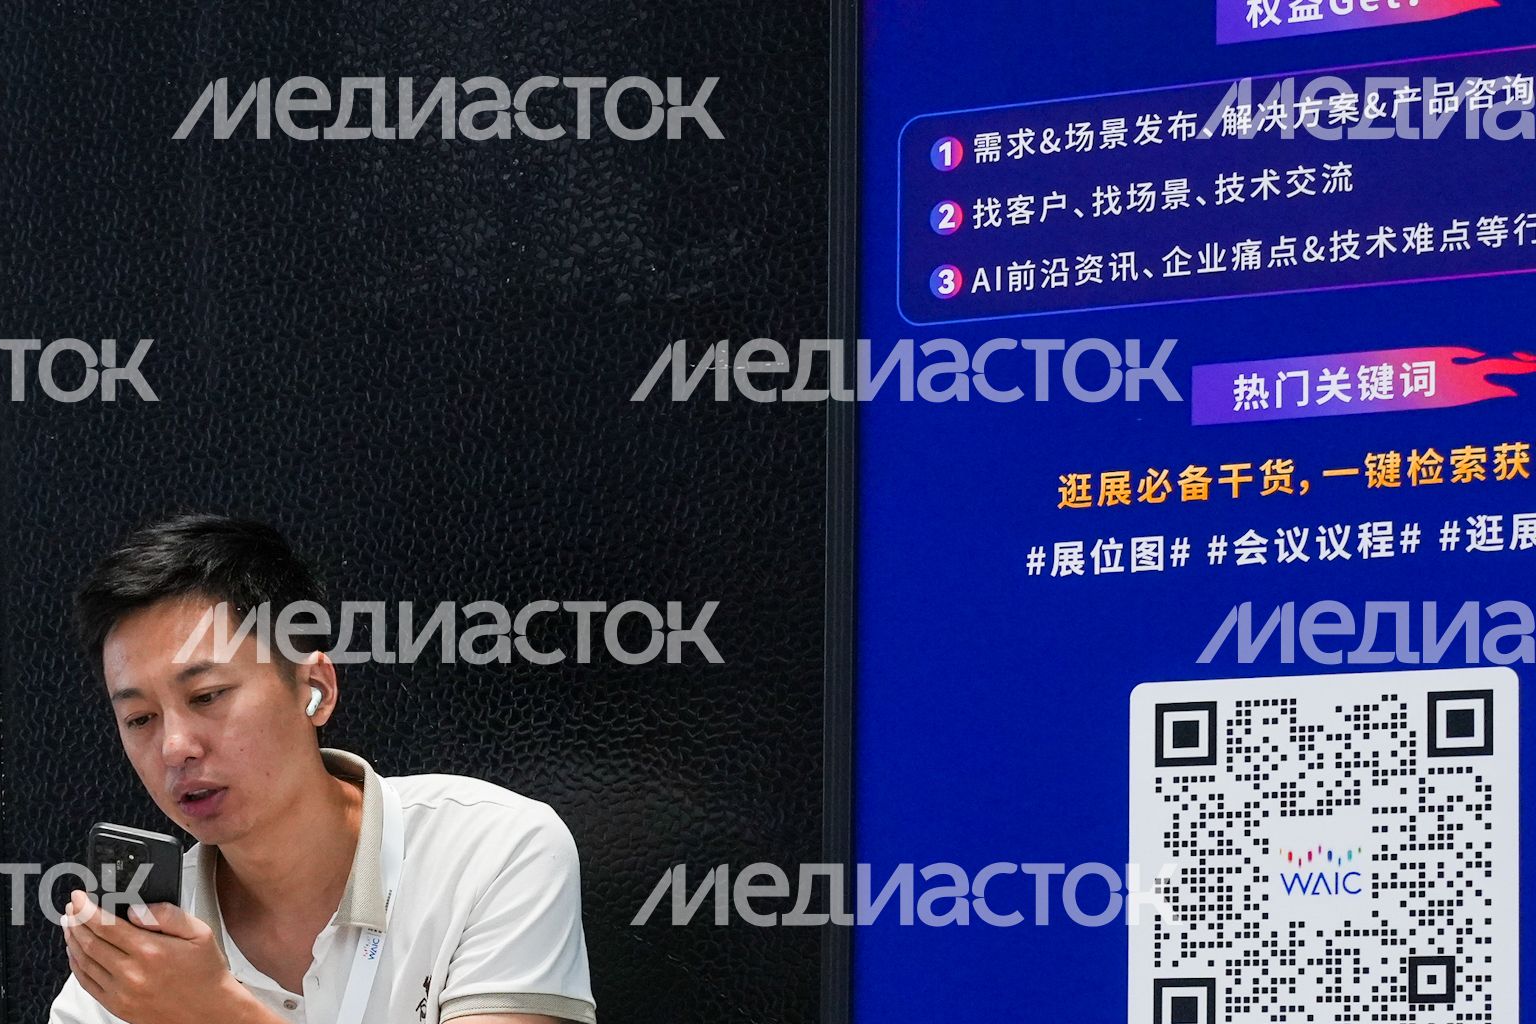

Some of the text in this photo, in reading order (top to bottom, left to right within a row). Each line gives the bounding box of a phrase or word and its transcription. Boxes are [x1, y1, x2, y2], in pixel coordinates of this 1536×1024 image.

[972, 160, 1355, 231] 找客户、找场景、技术交流
[1232, 360, 1438, 413] 热门关键词
[1025, 535, 1191, 580] #展位图#
[1207, 520, 1422, 567] #会议议程#
[1280, 871, 1362, 896] WAIC
